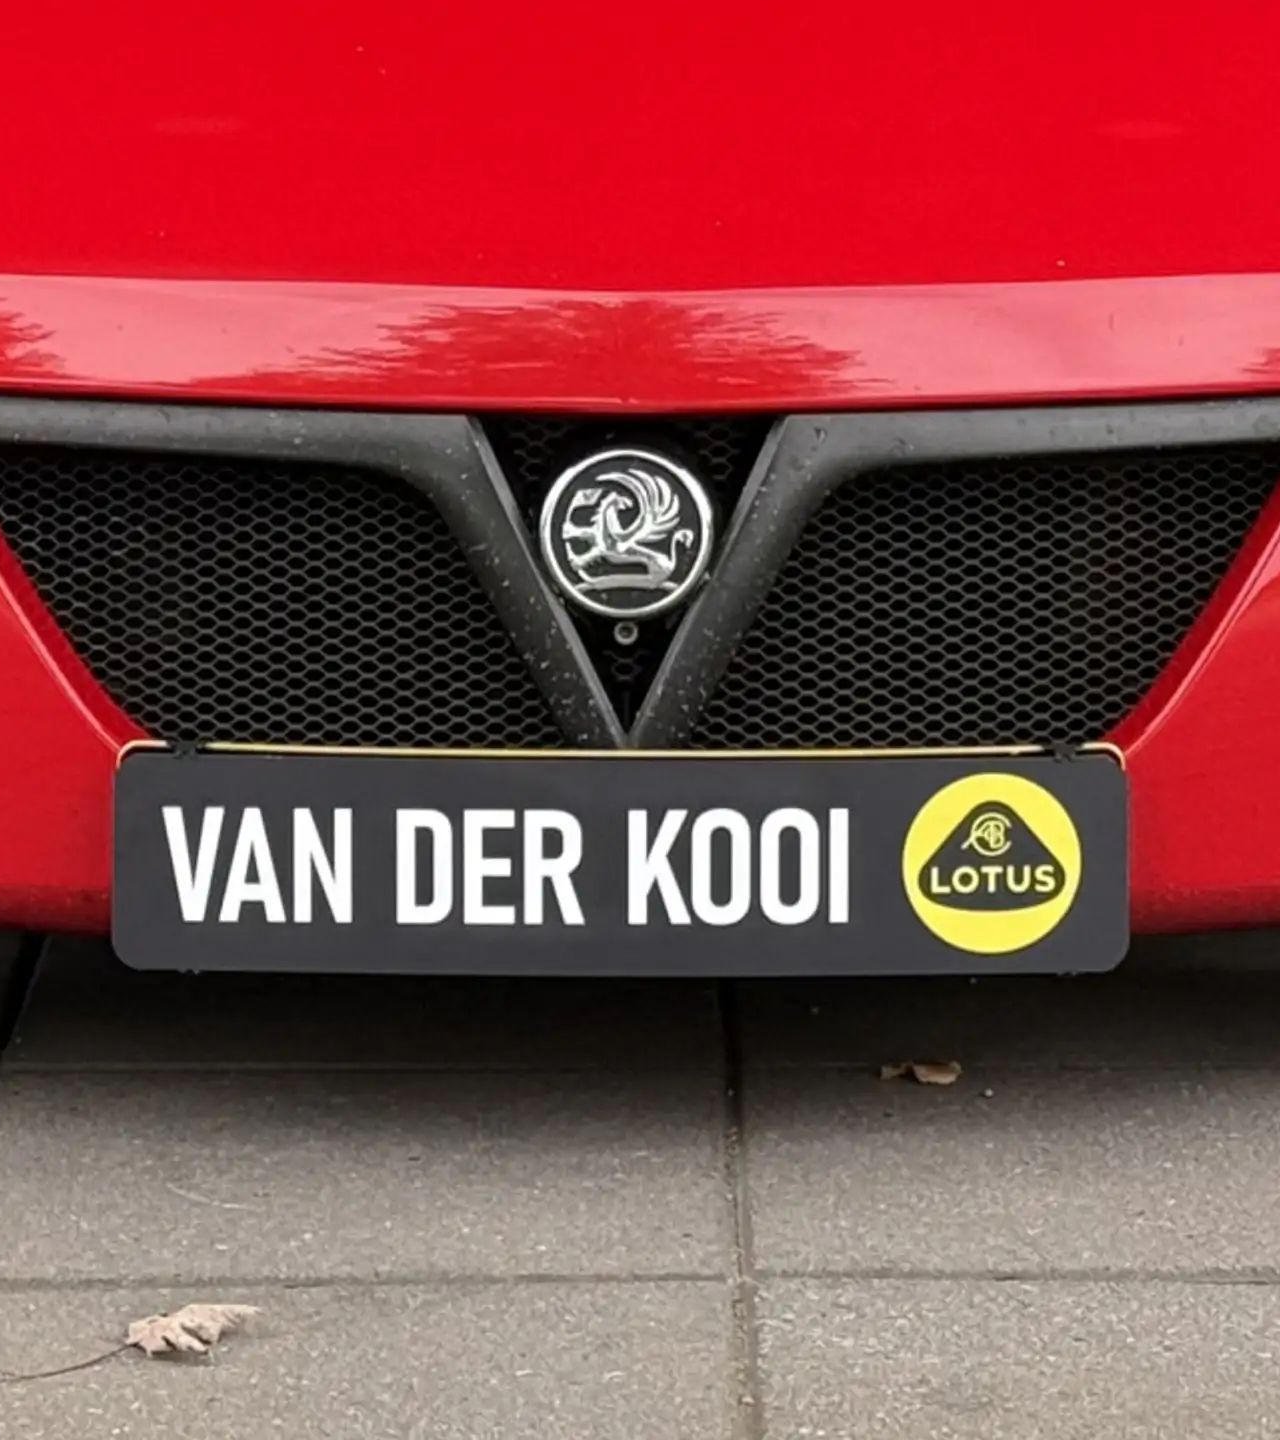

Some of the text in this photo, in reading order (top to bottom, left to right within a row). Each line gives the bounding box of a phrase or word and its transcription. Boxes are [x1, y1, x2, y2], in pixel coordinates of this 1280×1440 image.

[164, 805, 851, 927] VAN DER KOOI
[929, 864, 1057, 899] LOTUS
